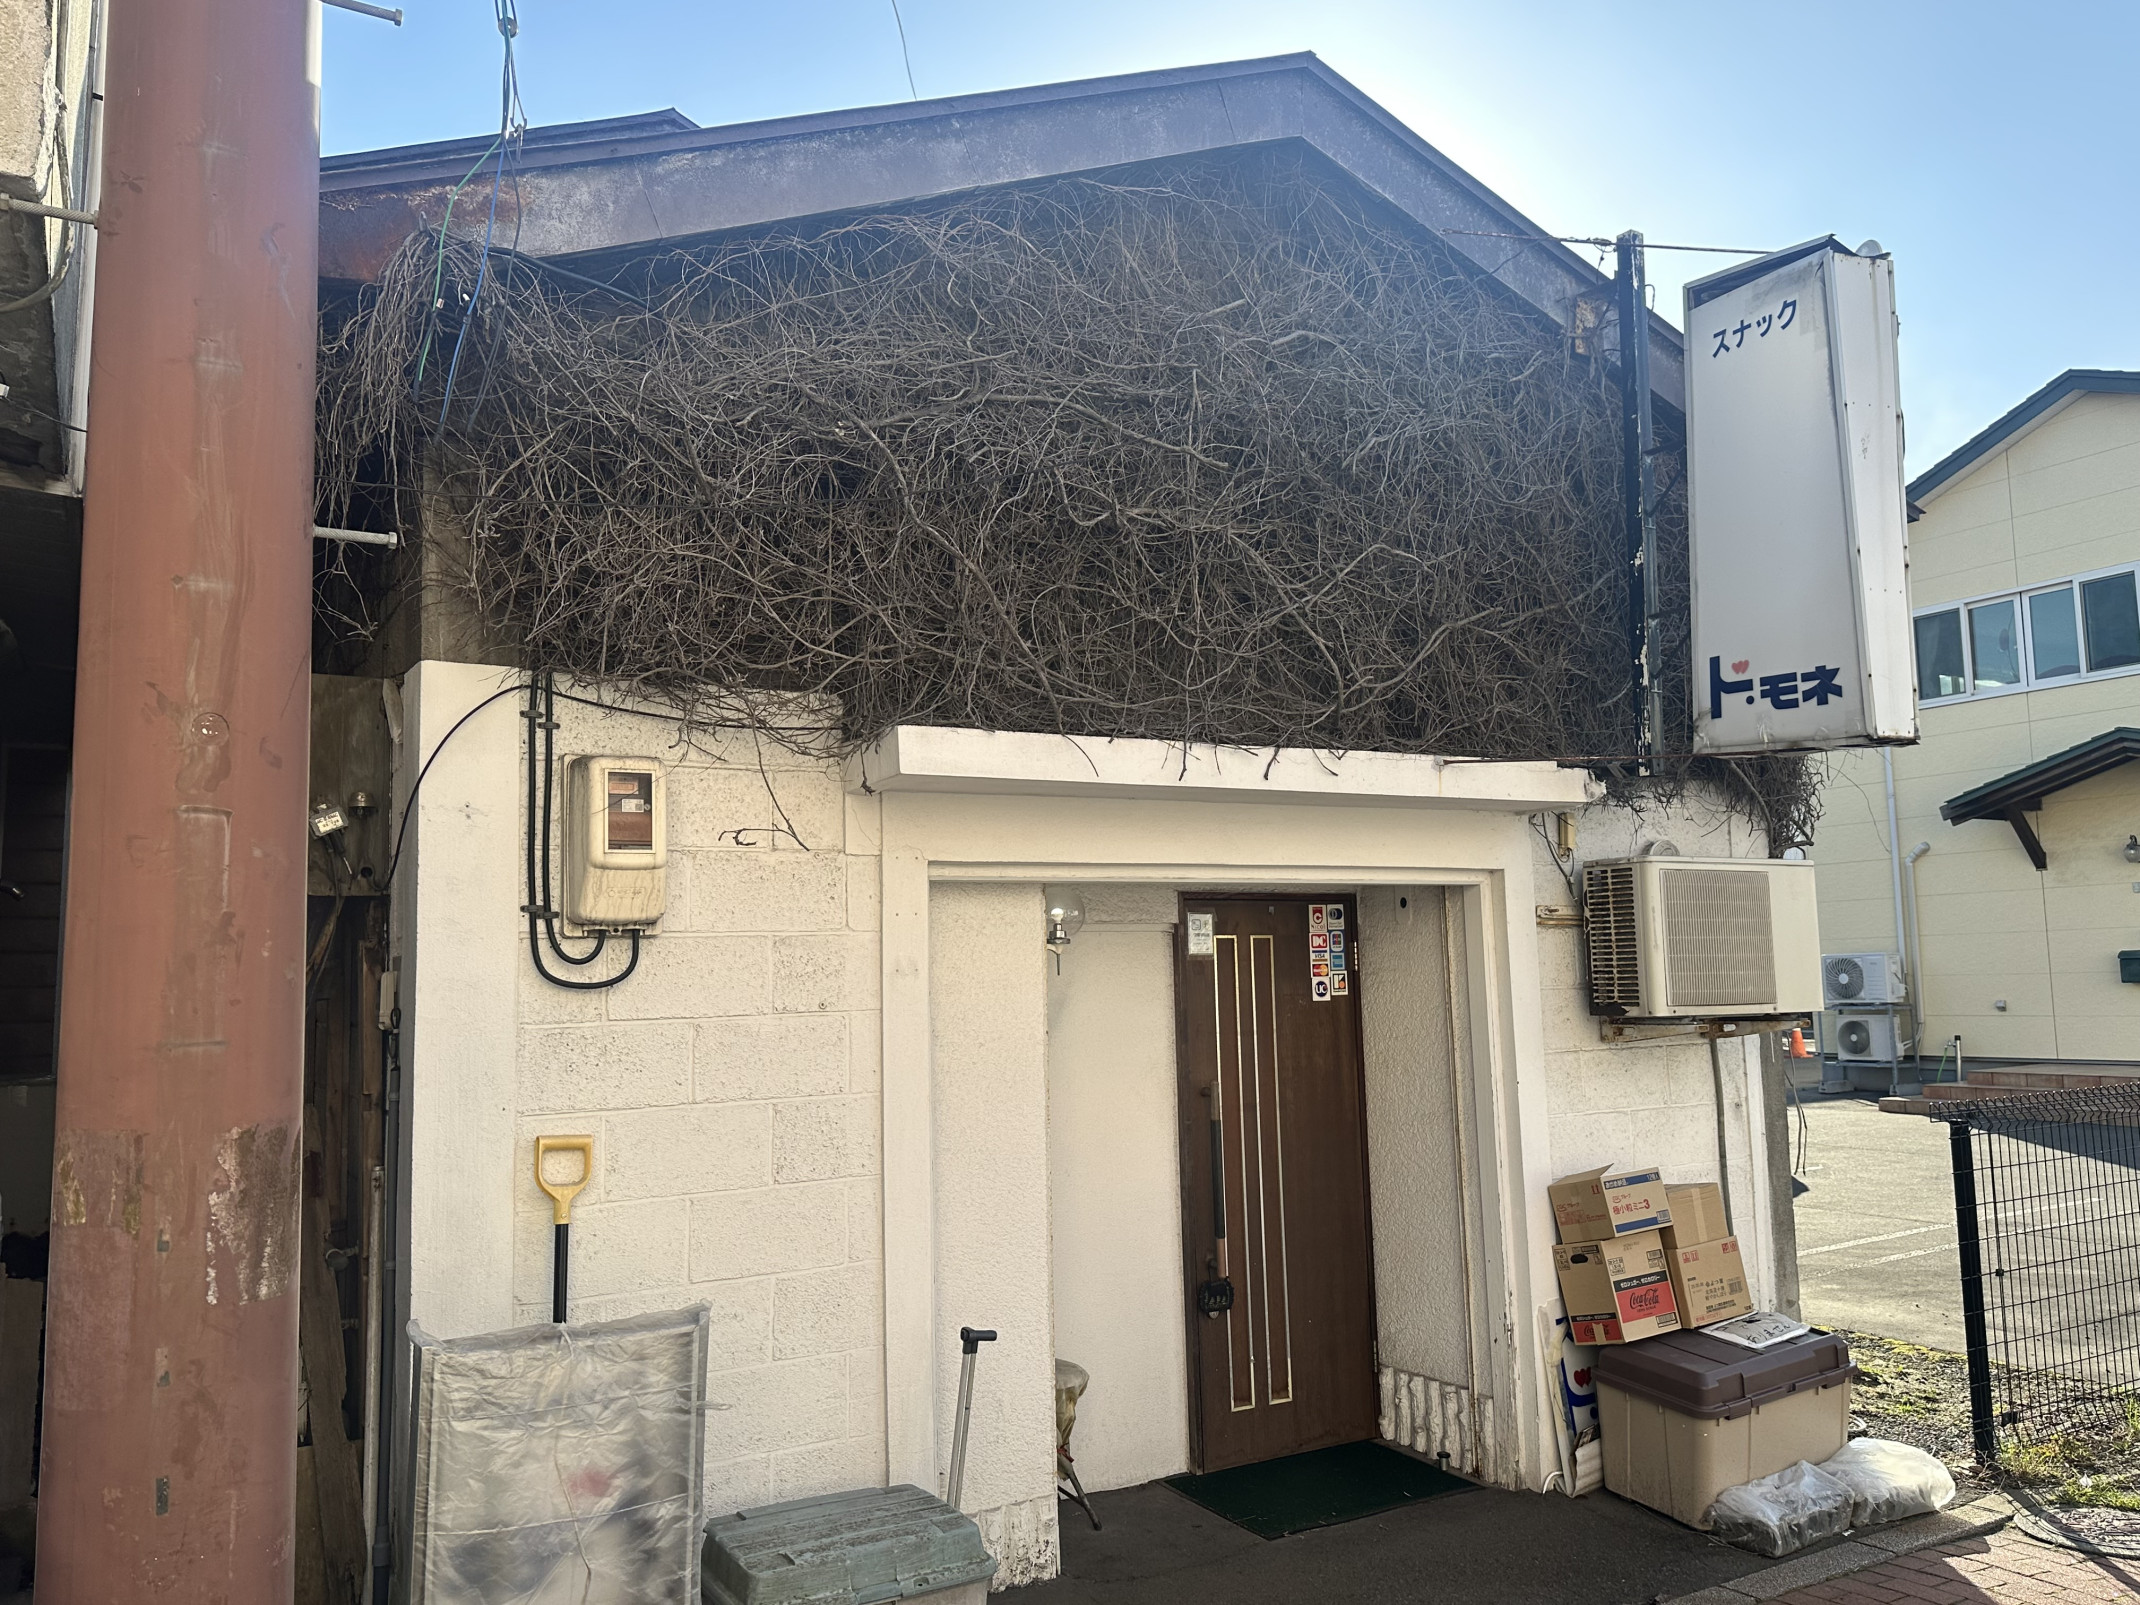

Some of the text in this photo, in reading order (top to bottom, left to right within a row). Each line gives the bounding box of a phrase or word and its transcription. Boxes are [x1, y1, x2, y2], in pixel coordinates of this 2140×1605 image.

[1712, 299, 1797, 359] スナック
[1312, 935, 1326, 947] DC
[1315, 984, 1328, 994] UC
